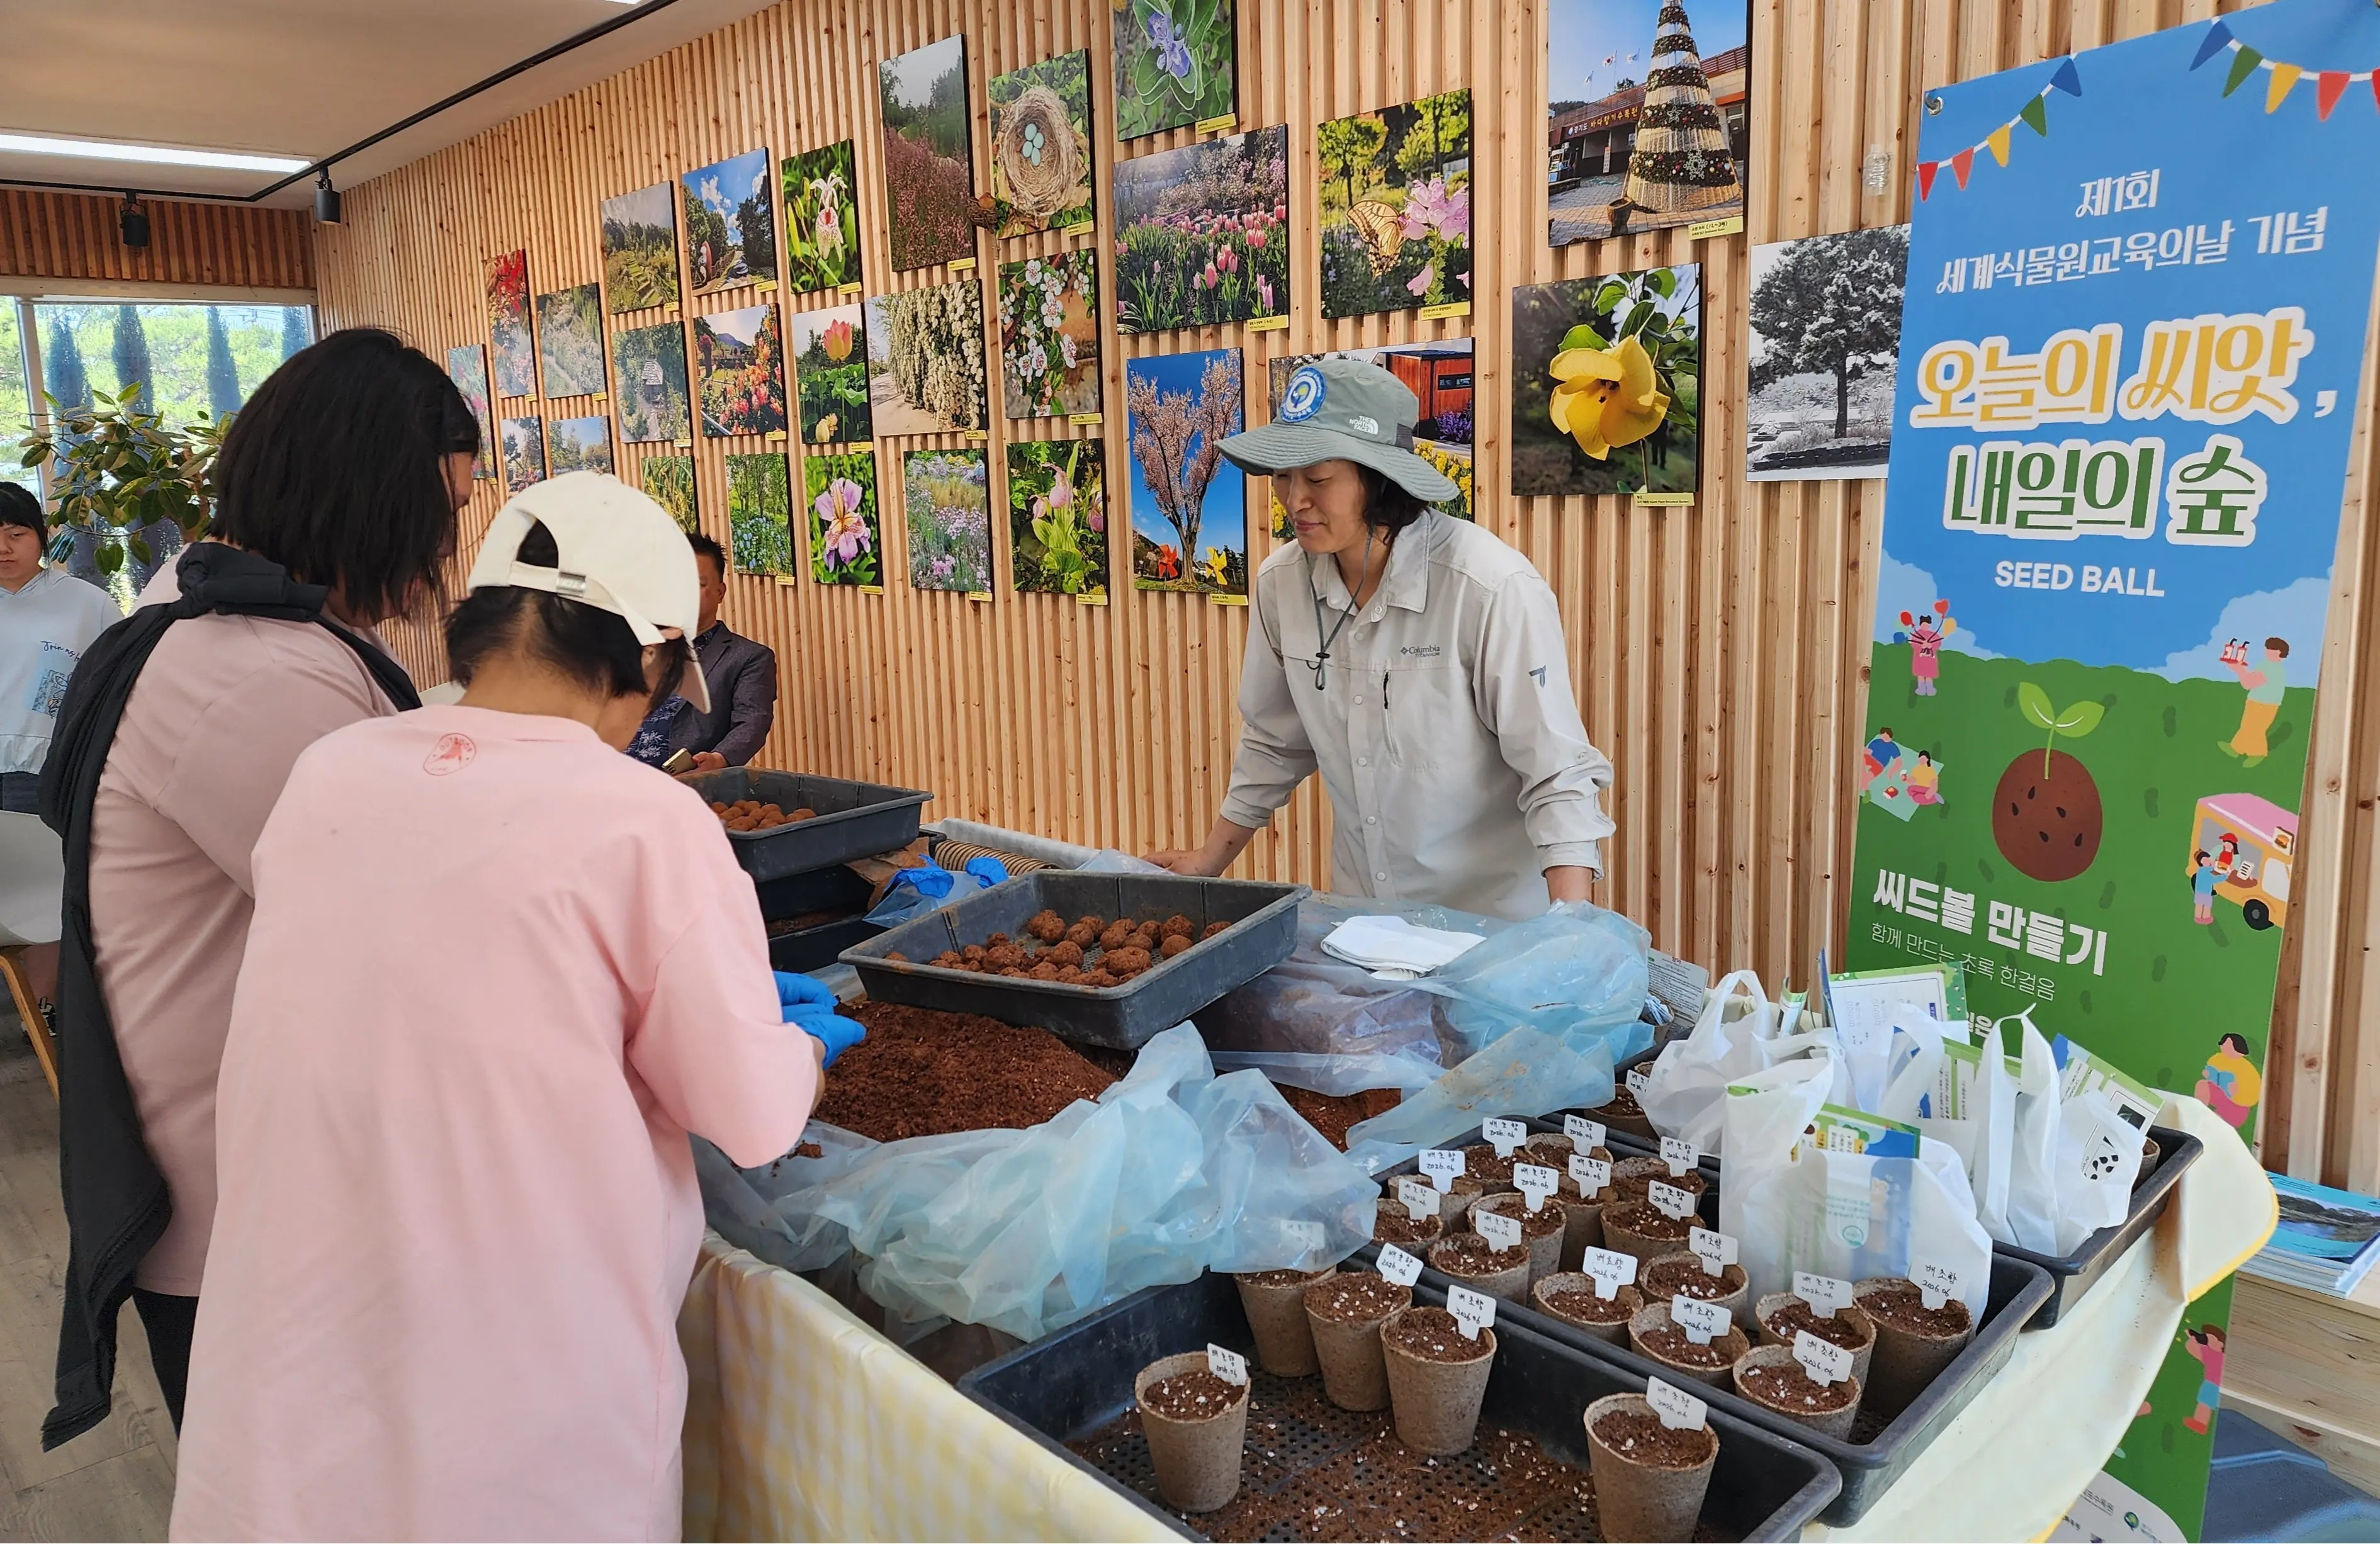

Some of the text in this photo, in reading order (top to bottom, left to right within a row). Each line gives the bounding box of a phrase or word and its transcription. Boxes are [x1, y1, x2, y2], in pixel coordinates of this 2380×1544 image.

[1590, 106, 1638, 128] 바다향기수목원
[2075, 168, 2160, 218] 제1회
[1936, 206, 2328, 295] 세계식물원교육의날 기념
[1915, 331, 2116, 424] 오늘의
[1949, 443, 2257, 536] 내일의 숲
[1994, 560, 2165, 597] SEED BALL
[1409, 645, 1440, 654] Columbia
[1871, 922, 1902, 950] 함께
[1905, 933, 1954, 963] 만드는
[2000, 964, 2056, 1001] 한걸음
[1873, 868, 2107, 977] 씨드볼 만들기
